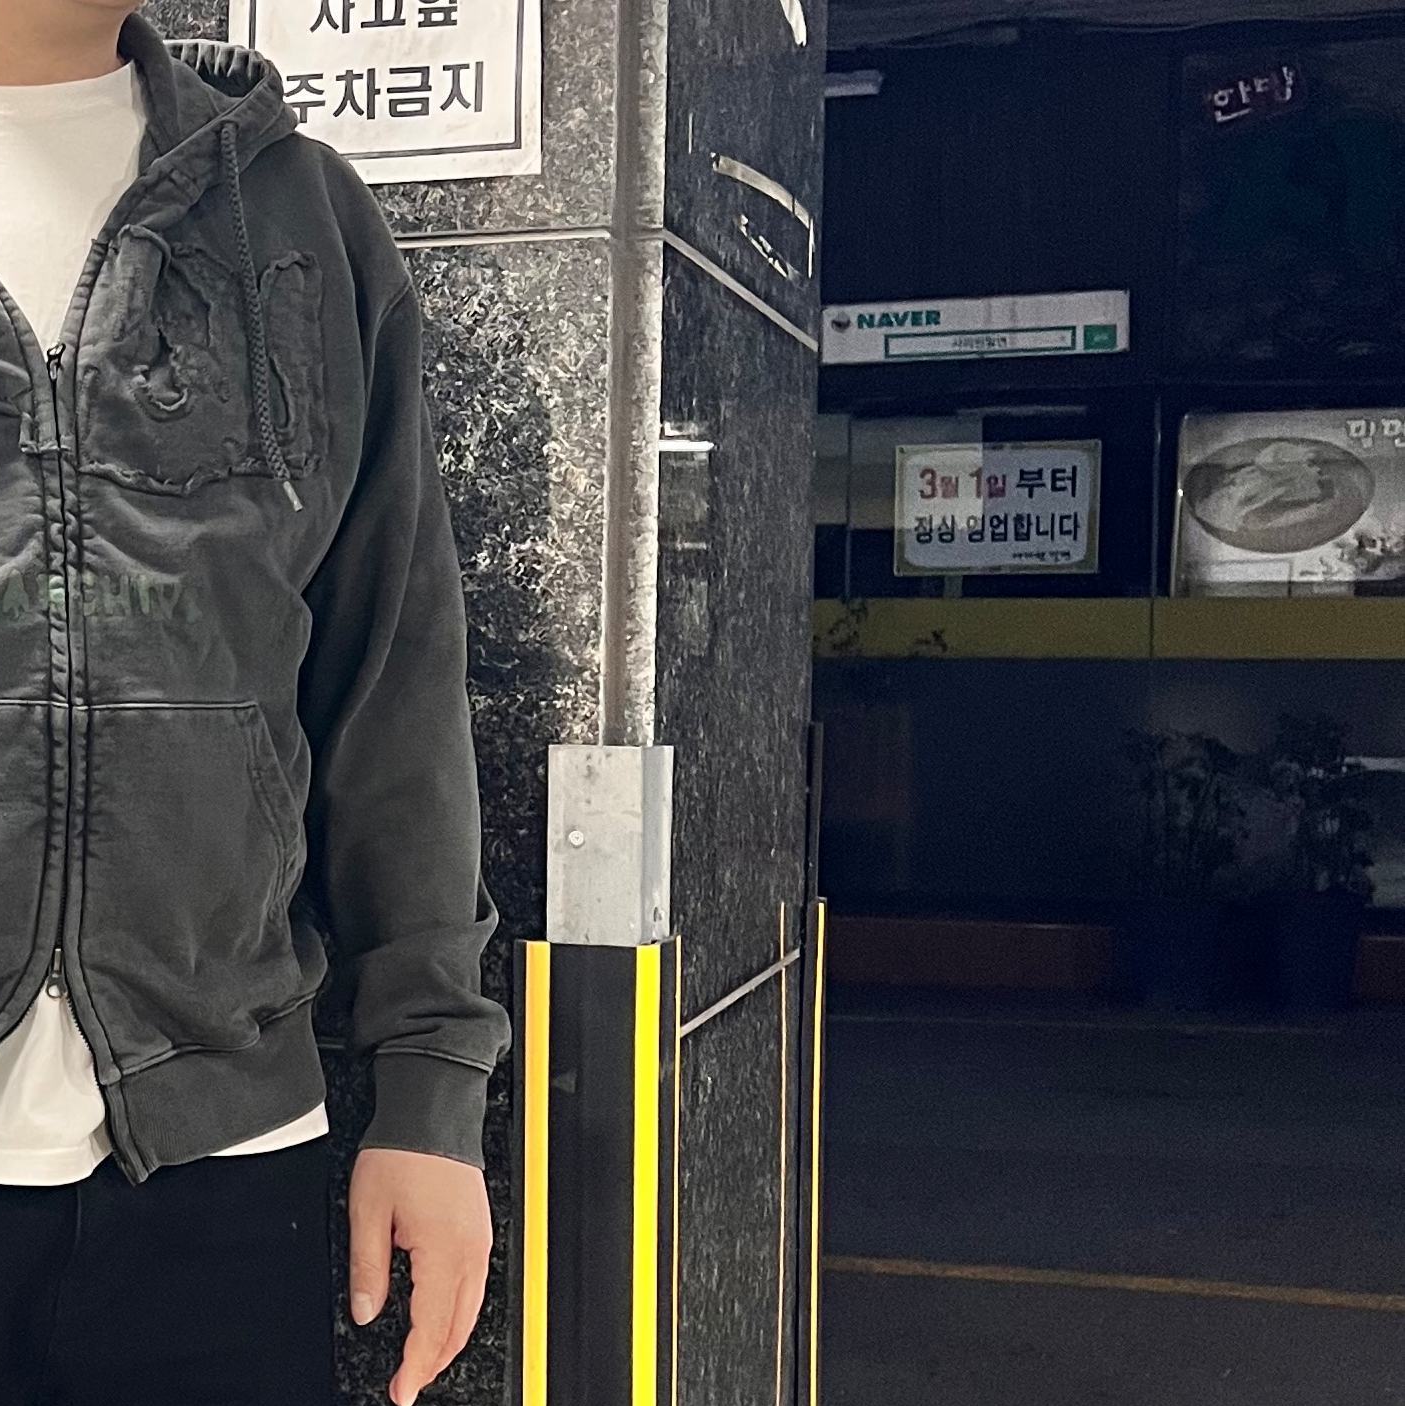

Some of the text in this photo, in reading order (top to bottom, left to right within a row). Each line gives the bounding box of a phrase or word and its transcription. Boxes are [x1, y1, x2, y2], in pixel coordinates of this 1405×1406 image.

[283, 61, 484, 124] 주차금지
[856, 309, 942, 330] NAVER
[918, 464, 1078, 500] 3월 1일 부터
[913, 511, 1081, 545] 정상 영업합니다
